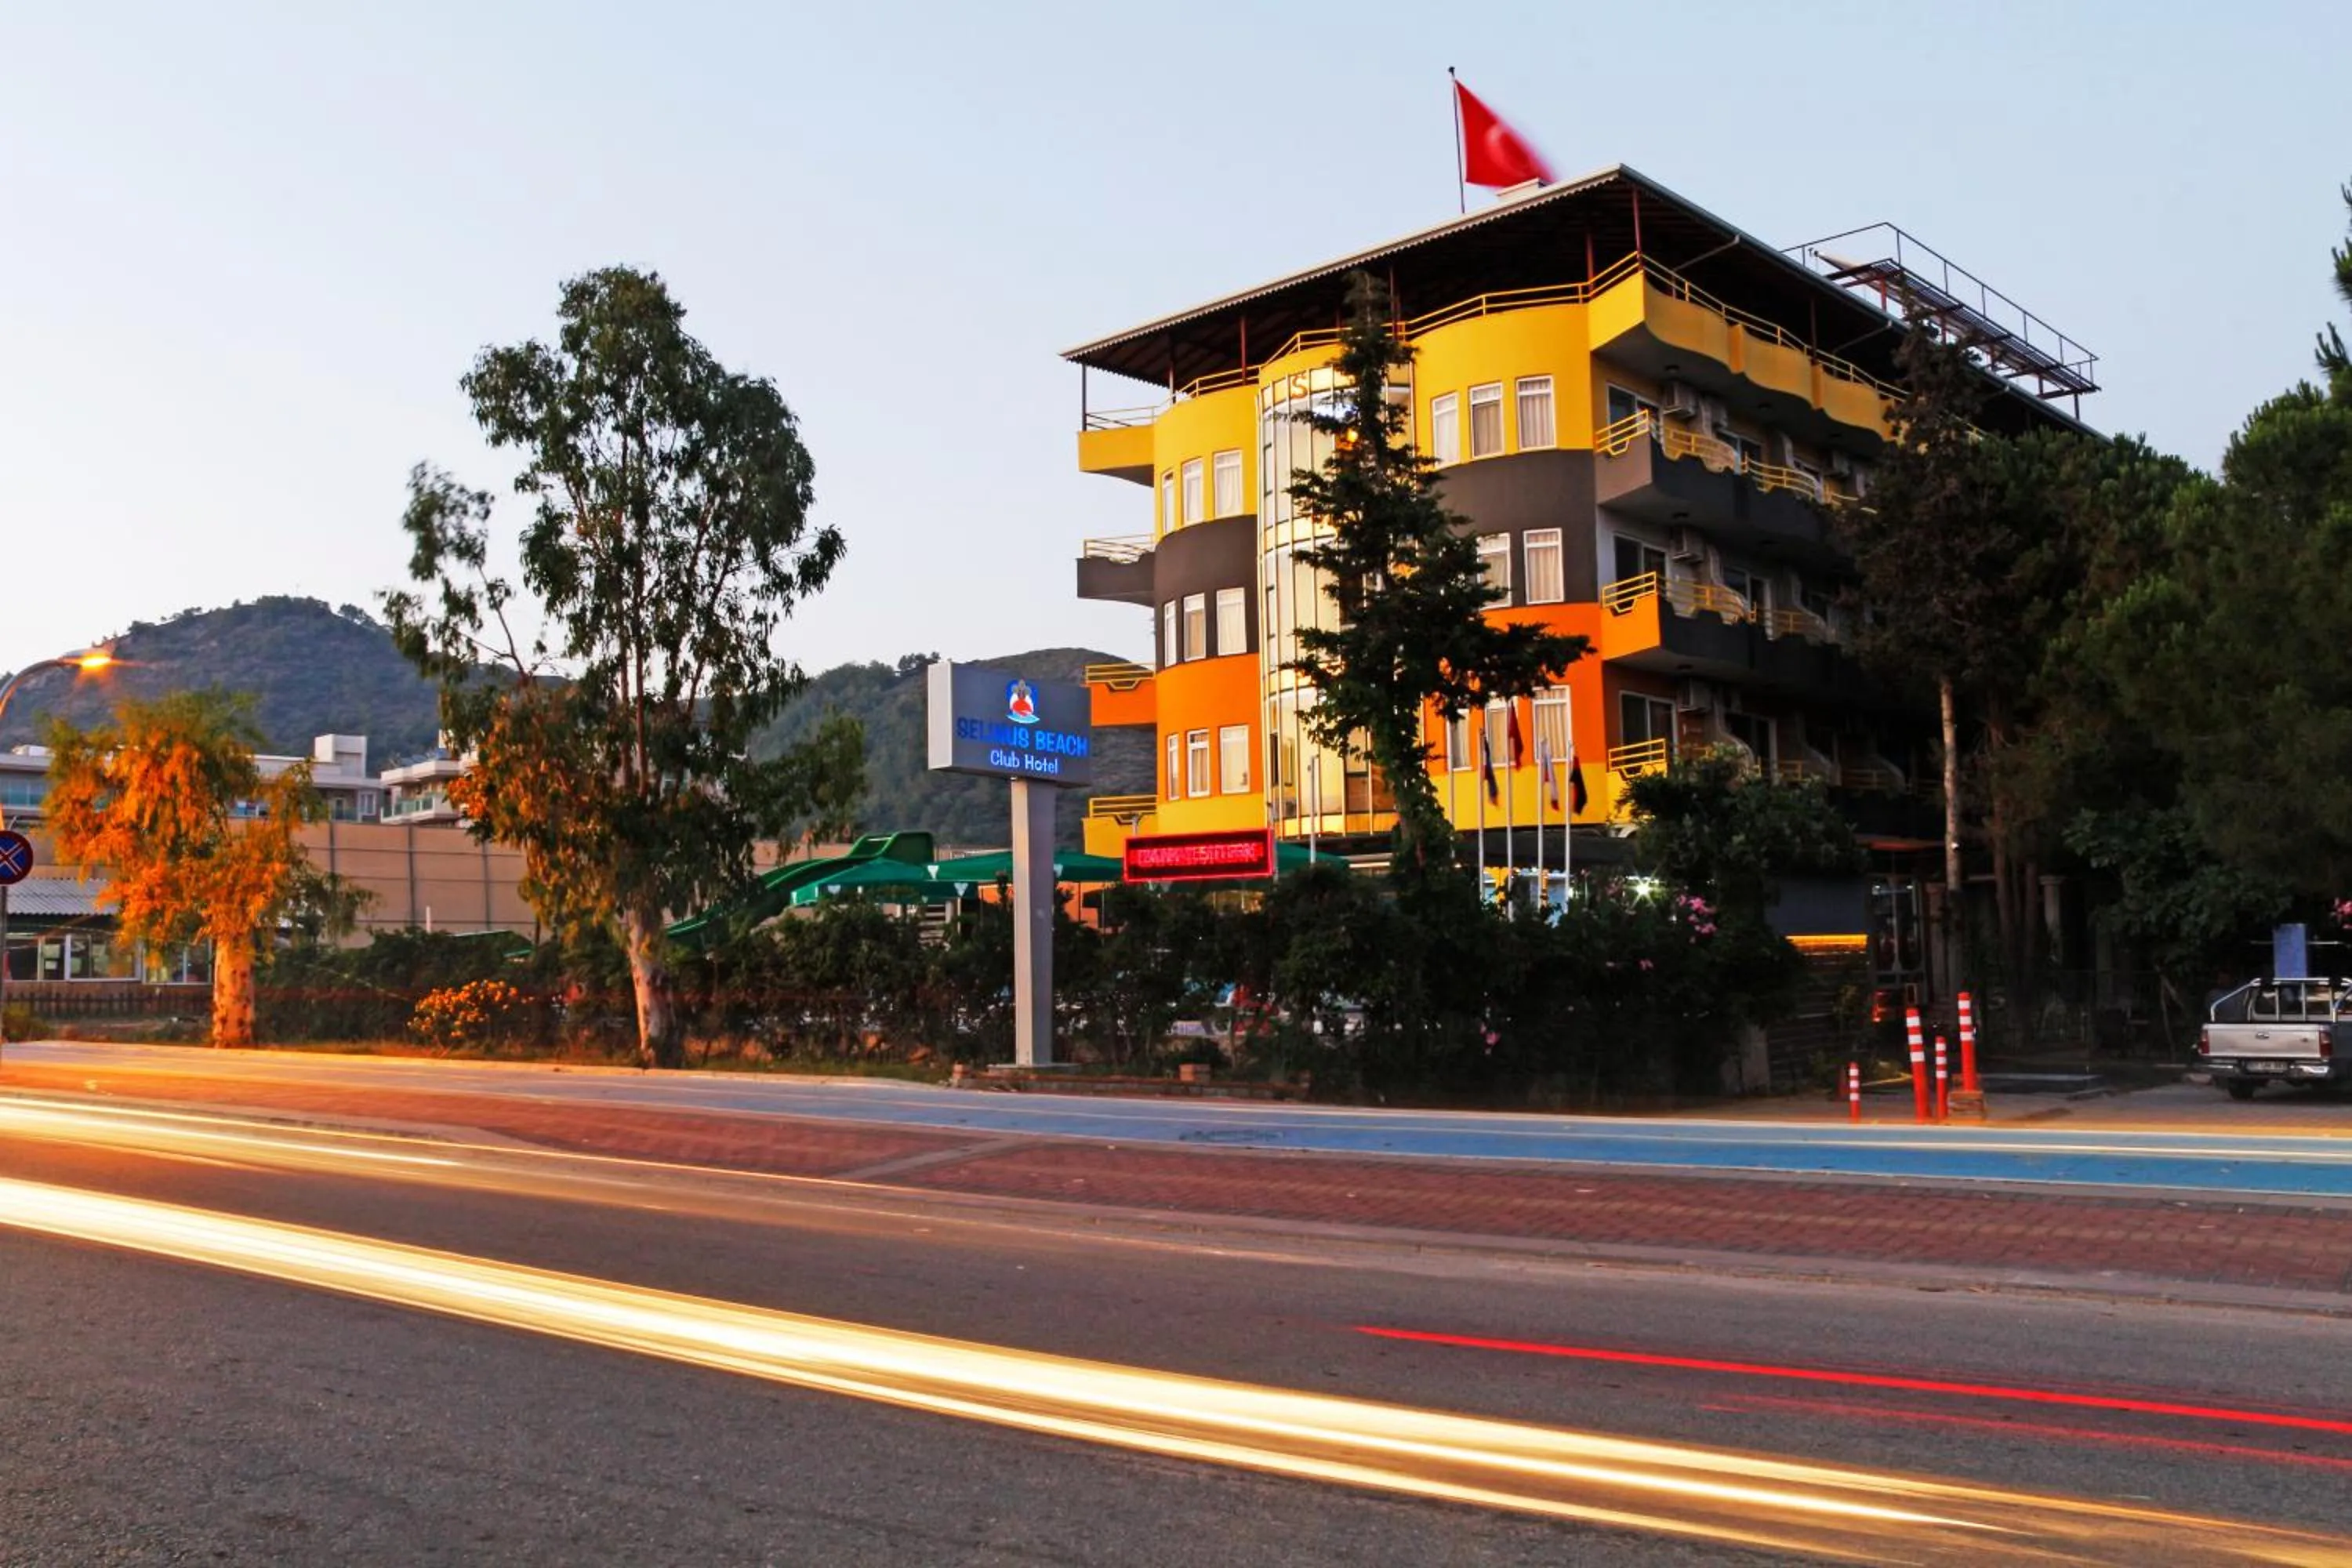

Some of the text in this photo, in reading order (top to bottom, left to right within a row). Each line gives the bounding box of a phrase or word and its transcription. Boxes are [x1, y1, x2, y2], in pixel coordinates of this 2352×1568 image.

[956, 717, 1088, 757] SELUS BEACH
[990, 750, 1058, 774] Club Hotel
